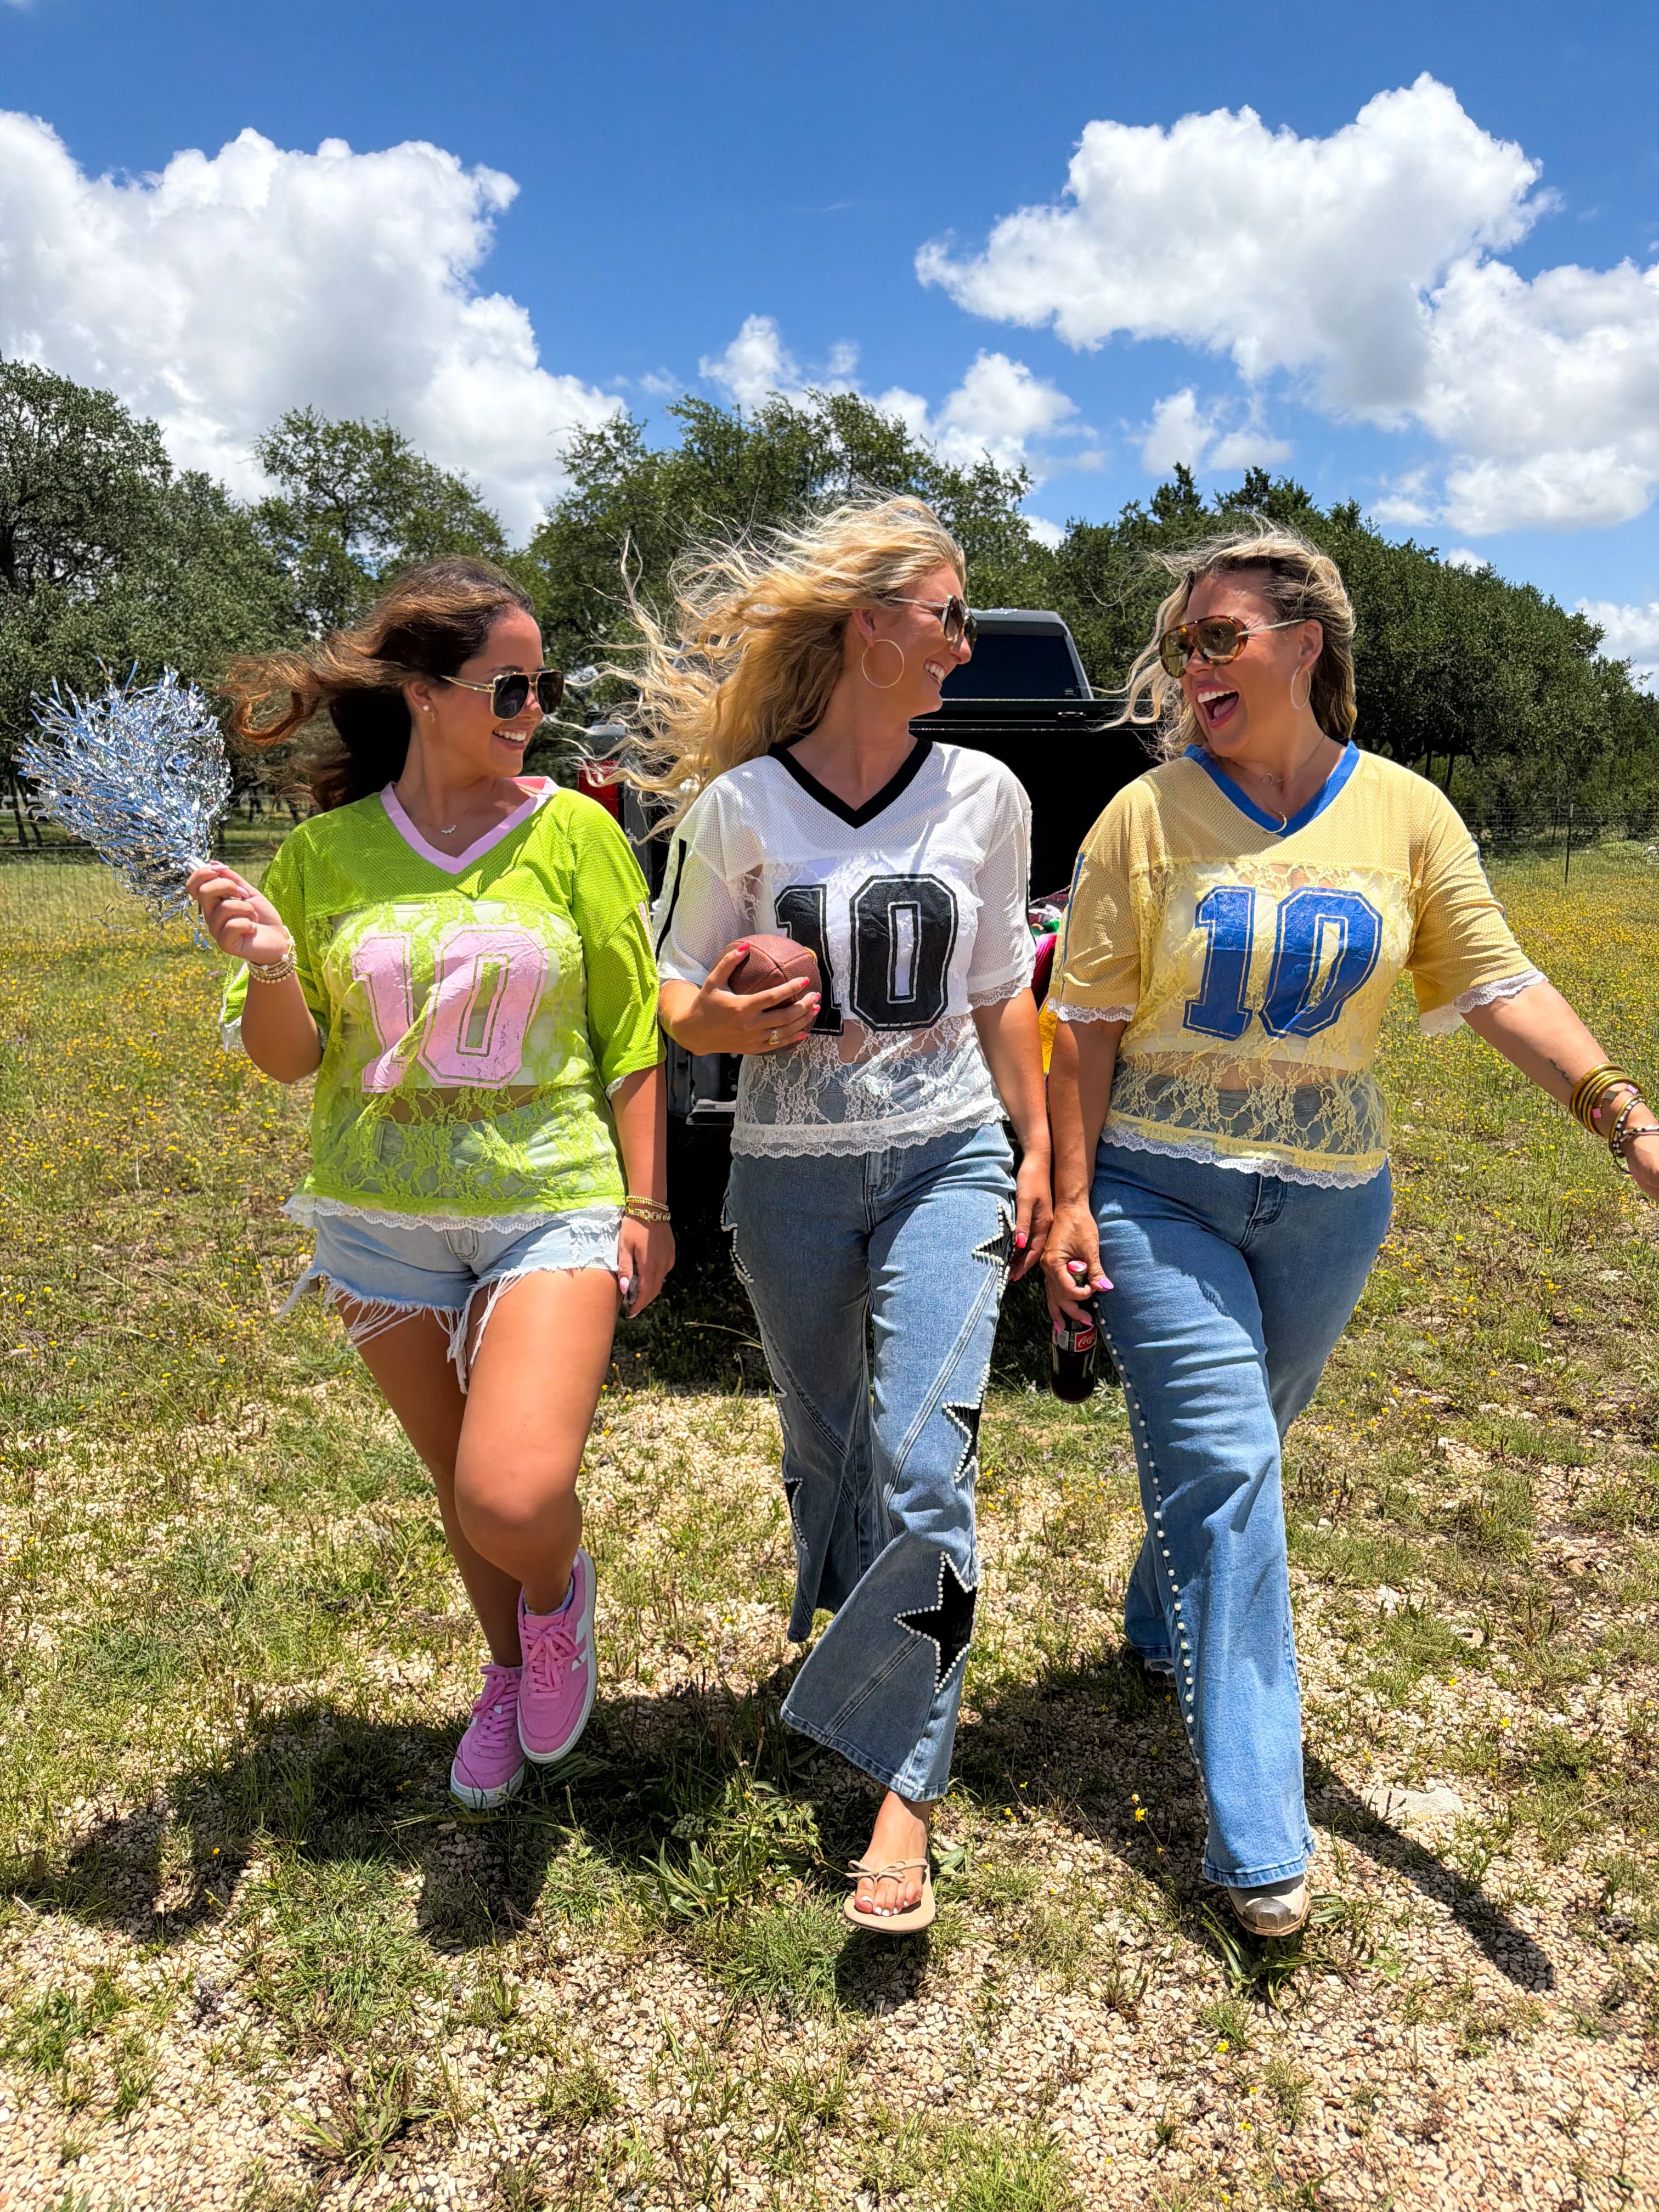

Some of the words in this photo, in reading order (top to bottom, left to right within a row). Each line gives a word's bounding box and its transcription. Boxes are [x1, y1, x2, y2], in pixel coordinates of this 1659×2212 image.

[351, 924, 548, 1093] 10
[774, 873, 959, 1036] 10
[1183, 885, 1383, 1041] 10
